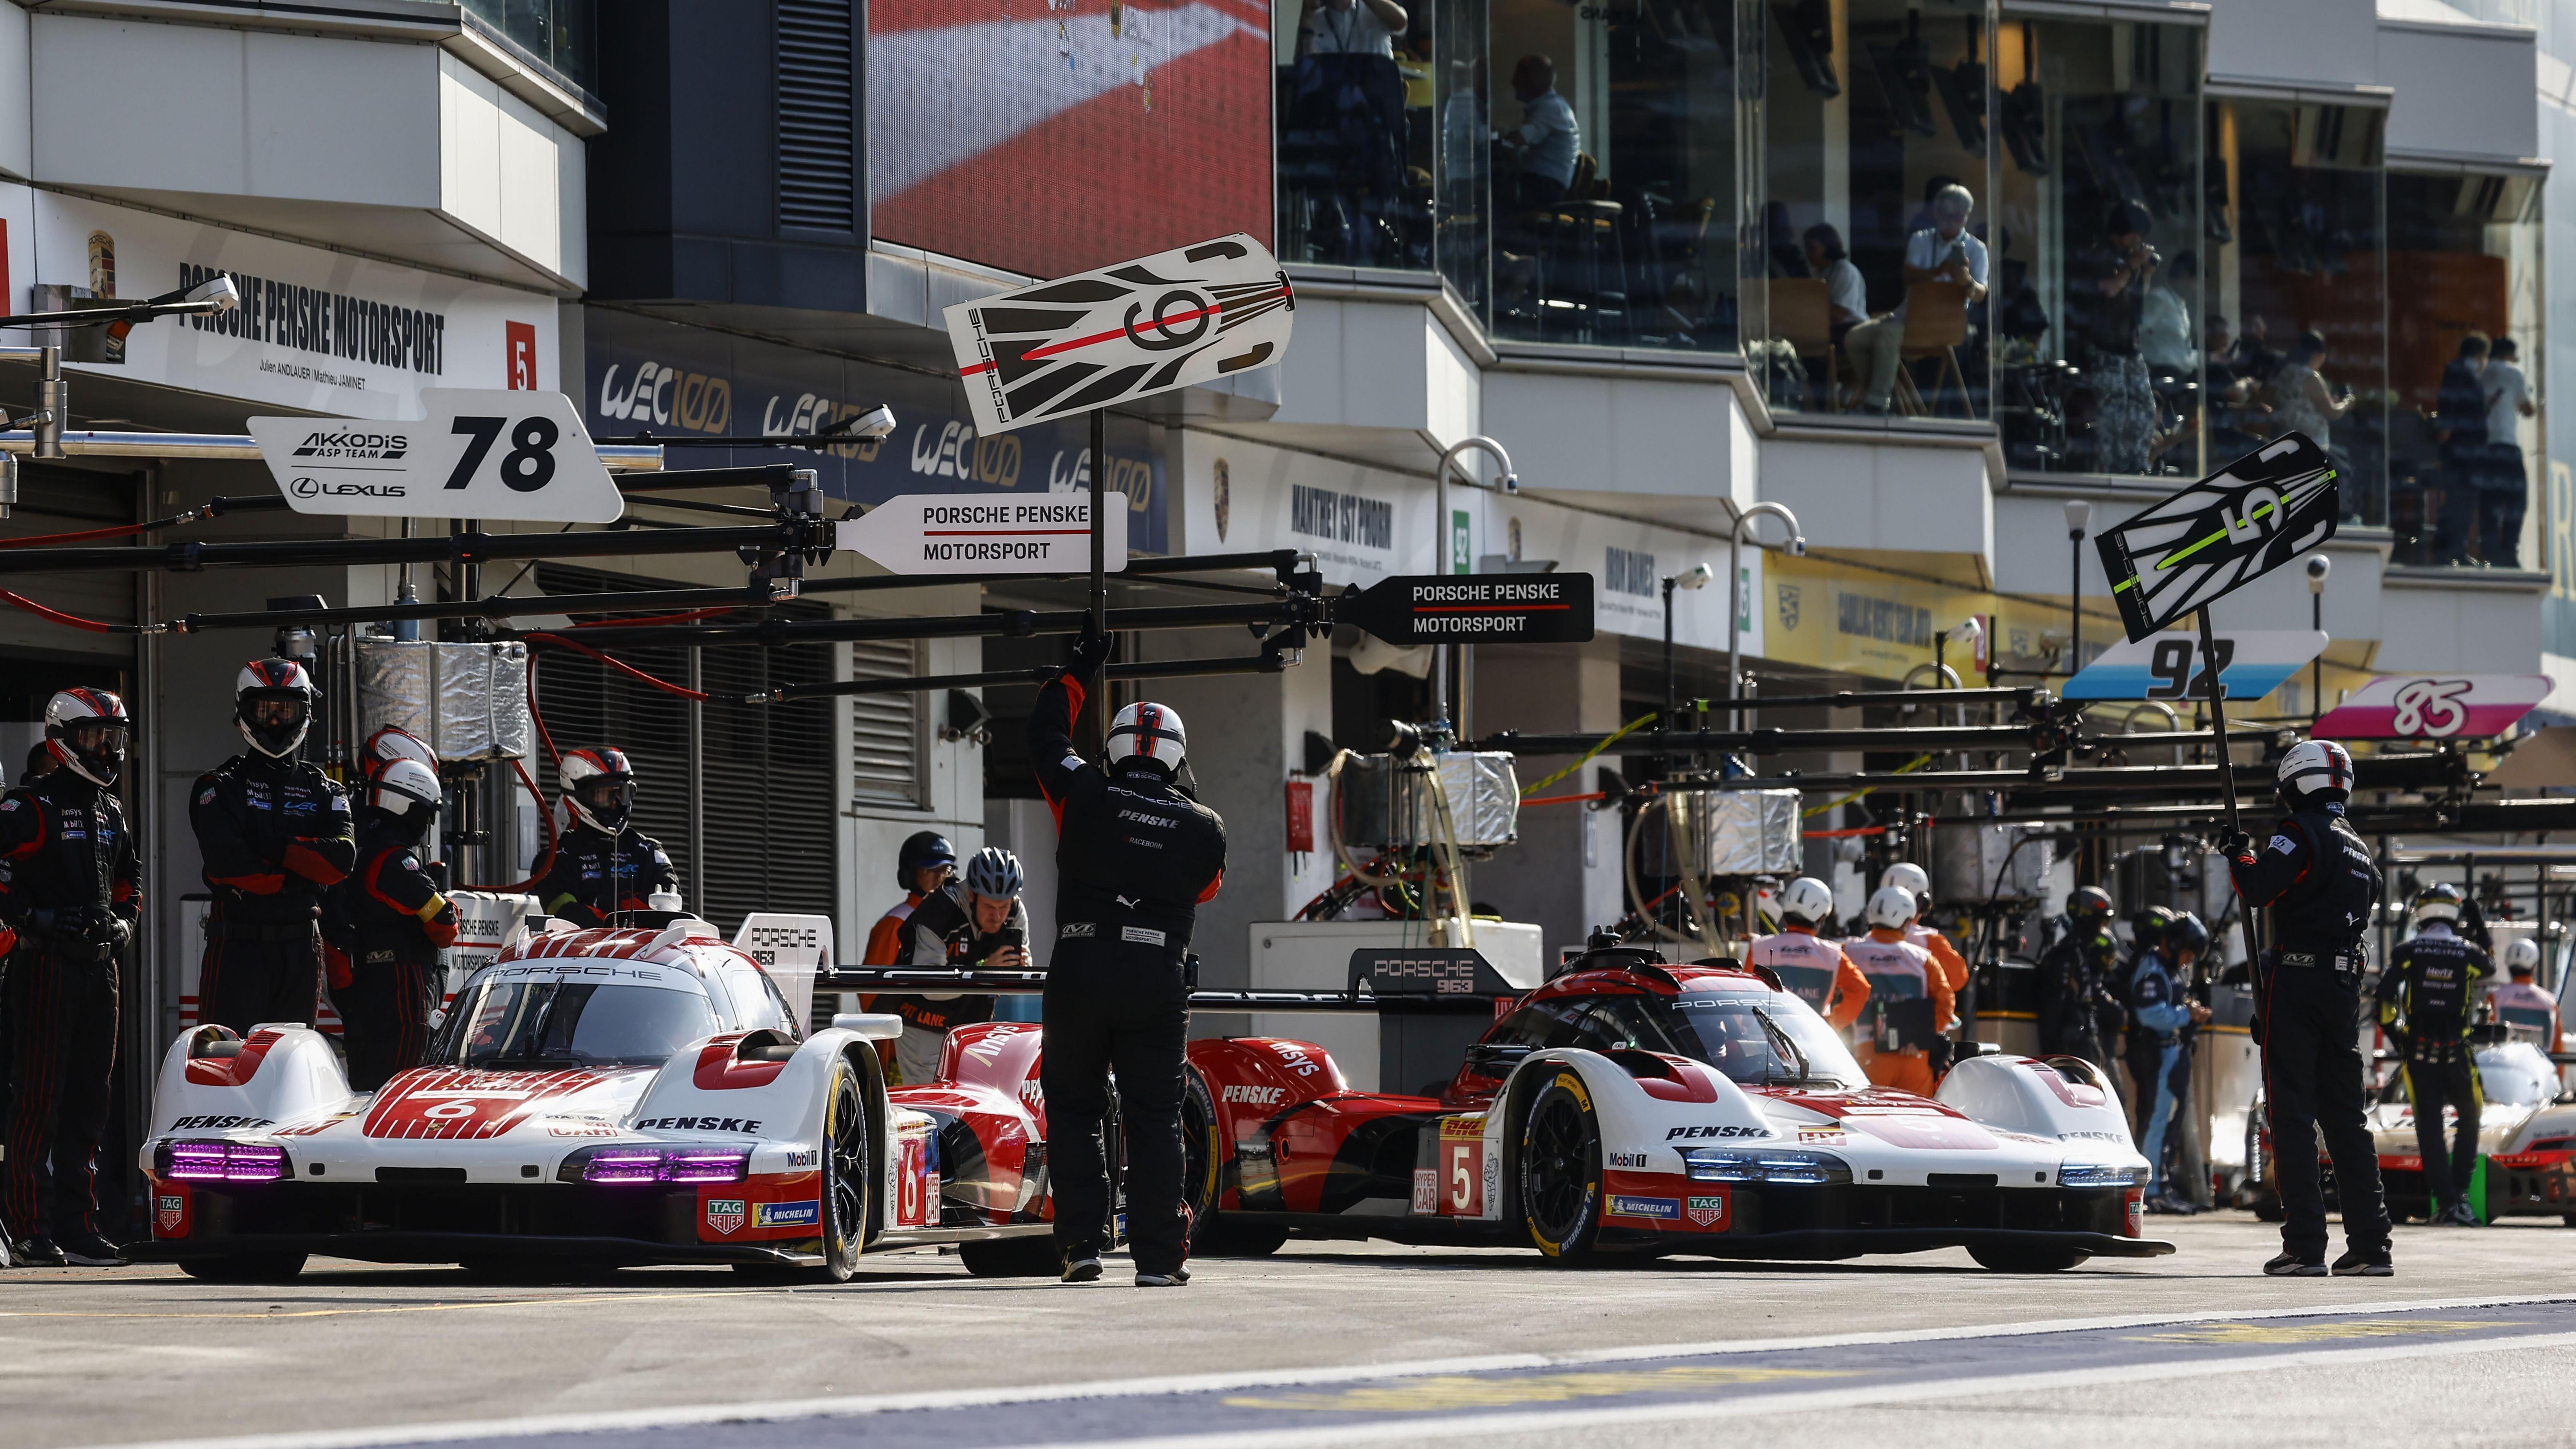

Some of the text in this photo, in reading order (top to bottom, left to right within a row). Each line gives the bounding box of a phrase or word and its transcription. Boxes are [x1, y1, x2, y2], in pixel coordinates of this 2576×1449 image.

[265, 279, 330, 355] PENSKE
[334, 294, 444, 376] MOTORSPORT
[1124, 290, 1209, 351] 6
[260, 359, 276, 373] Julien
[277, 362, 310, 380] ANDLAUER
[314, 370, 337, 386] Mathieu
[338, 374, 365, 390] JAMINET
[516, 342, 528, 390] 5
[968, 308, 1009, 423] PORSCHE
[316, 448, 379, 459] ASP TEAM
[443, 416, 559, 492] 78
[322, 484, 406, 497] LEXUS
[923, 505, 1089, 524] PORSCHE PENSKE
[2221, 486, 2283, 546] 5
[924, 542, 1051, 561] MOTORSPORT
[1413, 583, 1560, 601] PORSCHE PENSKE
[1413, 616, 1526, 633] MOTORSPORT
[2147, 639, 2235, 701] 92
[2393, 680, 2474, 738] 85
[1108, 786, 1193, 809] PORSCHE
[1117, 808, 1180, 829] PENSKE
[1129, 837, 1163, 849] RACEBORN
[2343, 845, 2370, 866] PENSKE
[478, 919, 499, 936] PENSKE
[752, 928, 816, 948] PORSCHE
[752, 951, 775, 965] 963
[483, 967, 662, 981] PORSCHE
[1375, 960, 1473, 977] PORSCHE
[1437, 980, 1473, 993] 963
[900, 1002, 947, 1027] PIT LANE
[964, 1025, 1021, 1068] Ansys
[1191, 1077, 1213, 1120] MICHELIN
[1221, 1085, 1285, 1105] PENSKE
[1581, 1099, 1588, 1109] M
[424, 1099, 477, 1118] 6
[168, 1116, 276, 1132] PENSKE
[635, 1117, 762, 1134] PENSKE
[1442, 1120, 1484, 1136] DHL
[1665, 1126, 1774, 1141] PENSKE
[788, 1150, 817, 1167] Mobil 1
[1609, 1153, 1634, 1167] Mobil
[905, 1145, 917, 1219] 6
[926, 1178, 939, 1194] HYPER
[1416, 1172, 1436, 1188] HYPER
[1452, 1146, 1470, 1209] 5
[161, 1199, 180, 1209] TAG
[711, 1203, 741, 1213] TAG
[926, 1194, 939, 1220] CAR
[1416, 1188, 1436, 1210] CAR
[1626, 1203, 1673, 1213] MICHELIN
[1690, 1199, 1718, 1208] TAG
[160, 1211, 181, 1230] HEUER
[773, 1207, 814, 1220] MICHELIN
[1690, 1210, 1720, 1225] HEUER
[709, 1215, 742, 1233] HEUER
[1562, 1205, 1588, 1252] MICHELIN
